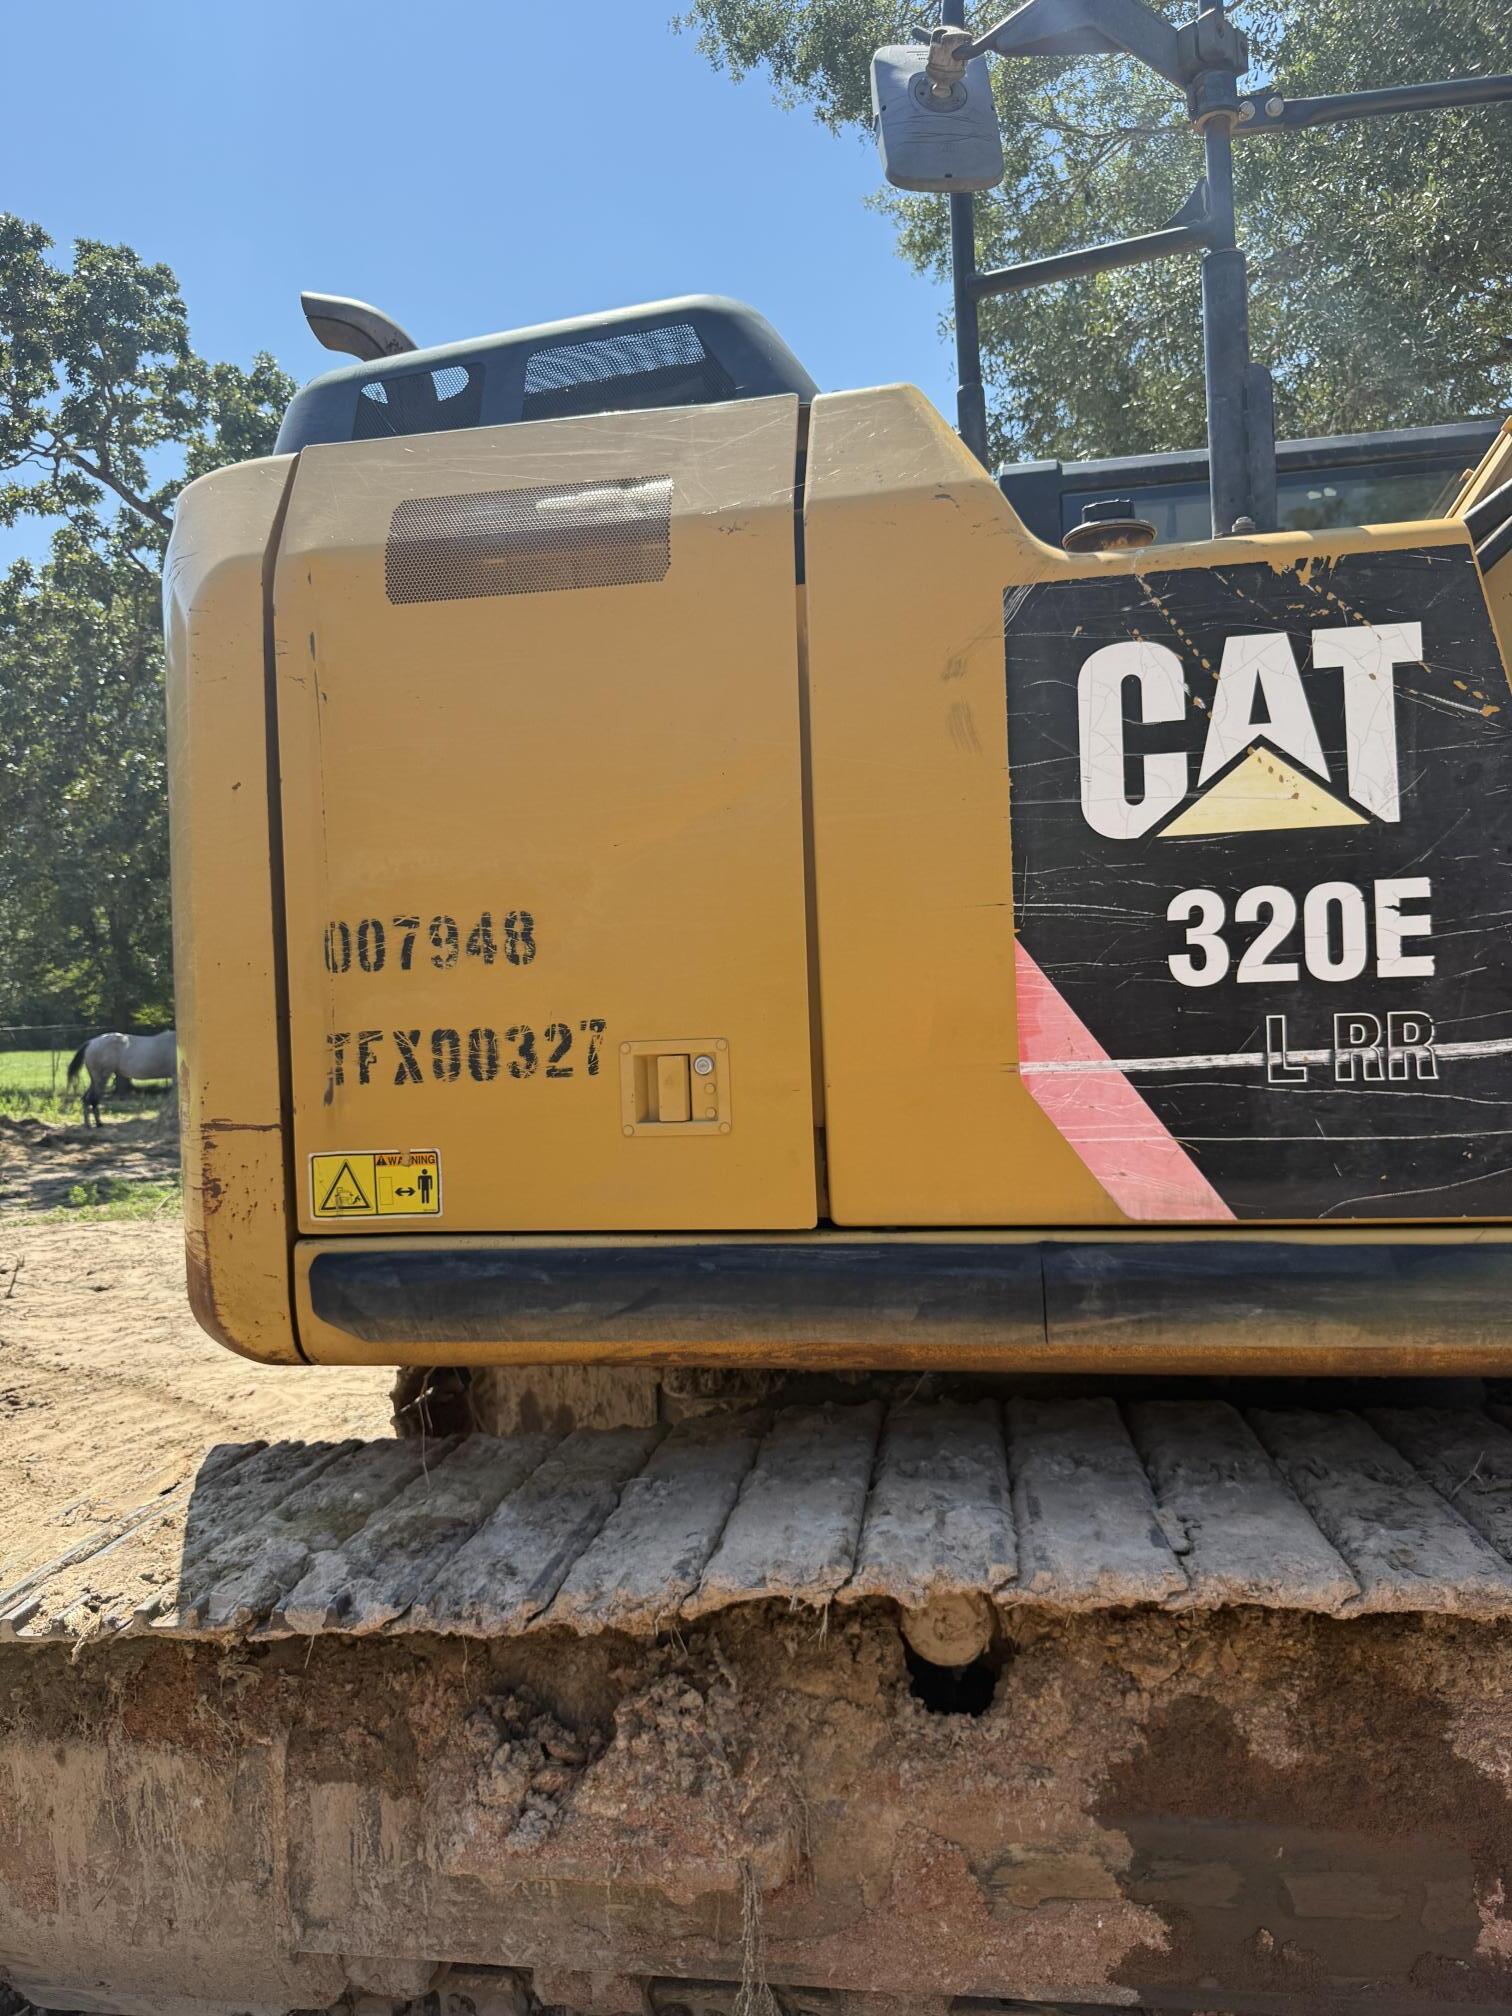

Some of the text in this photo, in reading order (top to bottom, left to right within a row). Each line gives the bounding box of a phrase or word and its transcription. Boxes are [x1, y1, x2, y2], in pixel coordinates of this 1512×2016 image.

[1078, 622, 1424, 840] CAT
[324, 911, 537, 974] 007948
[1167, 877, 1435, 988] 320E
[326, 1018, 607, 1086] TFX00327
[1266, 1010, 1440, 1084] L RR
[388, 1154, 436, 1166] WANING
